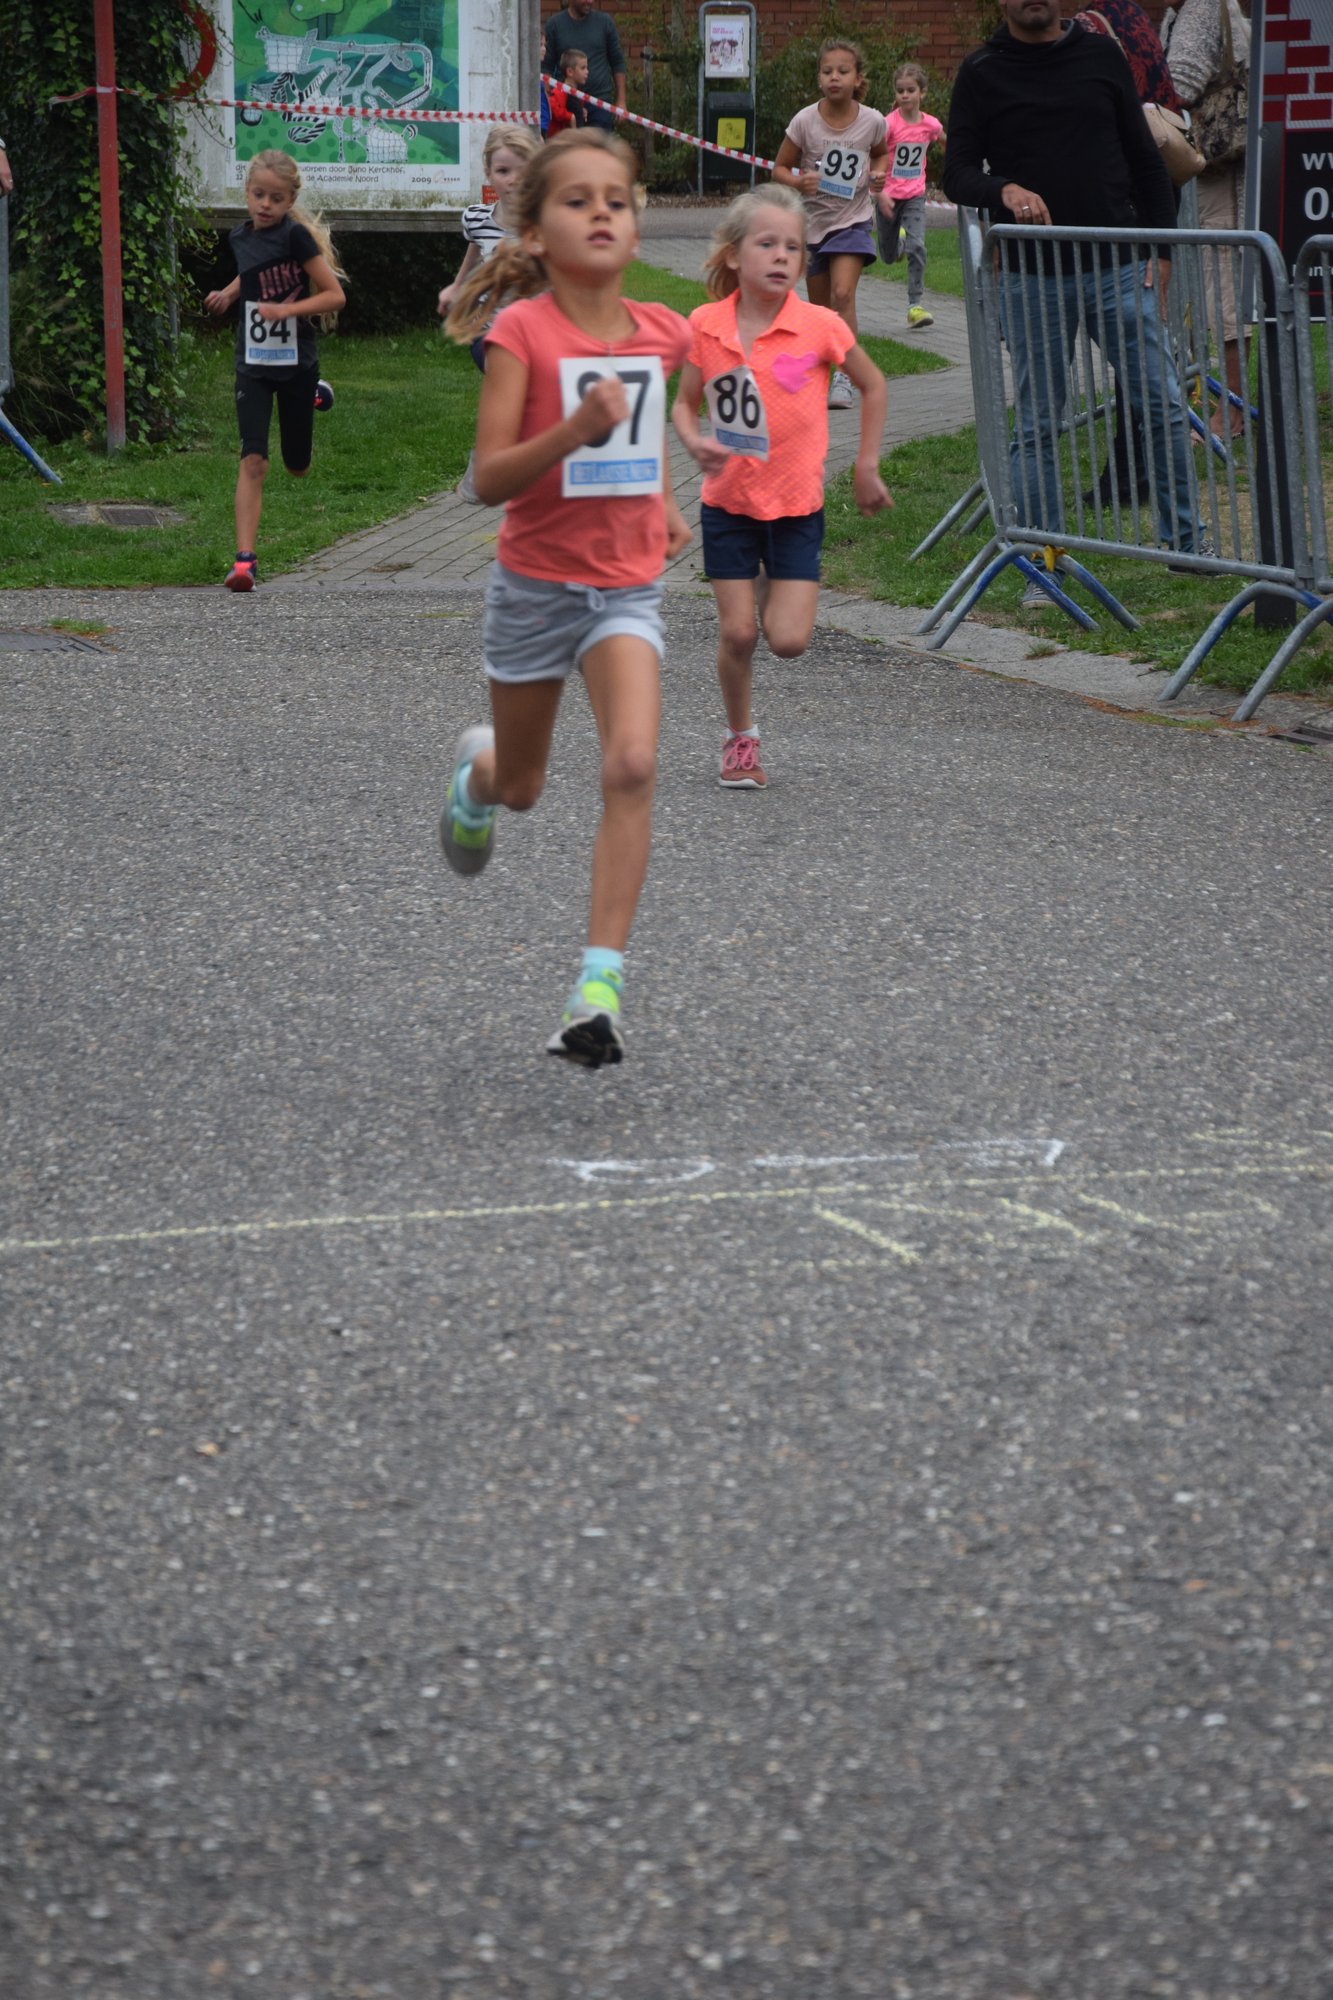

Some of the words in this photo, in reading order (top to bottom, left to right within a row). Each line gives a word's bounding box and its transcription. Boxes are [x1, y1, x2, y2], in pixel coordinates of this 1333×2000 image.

[824, 149, 859, 181] 93
[895, 145, 923, 168] 92
[328, 165, 346, 173] door
[355, 175, 379, 183] Noord
[411, 176, 432, 184] 2009
[249, 308, 291, 344] 84
[713, 374, 760, 429] 86
